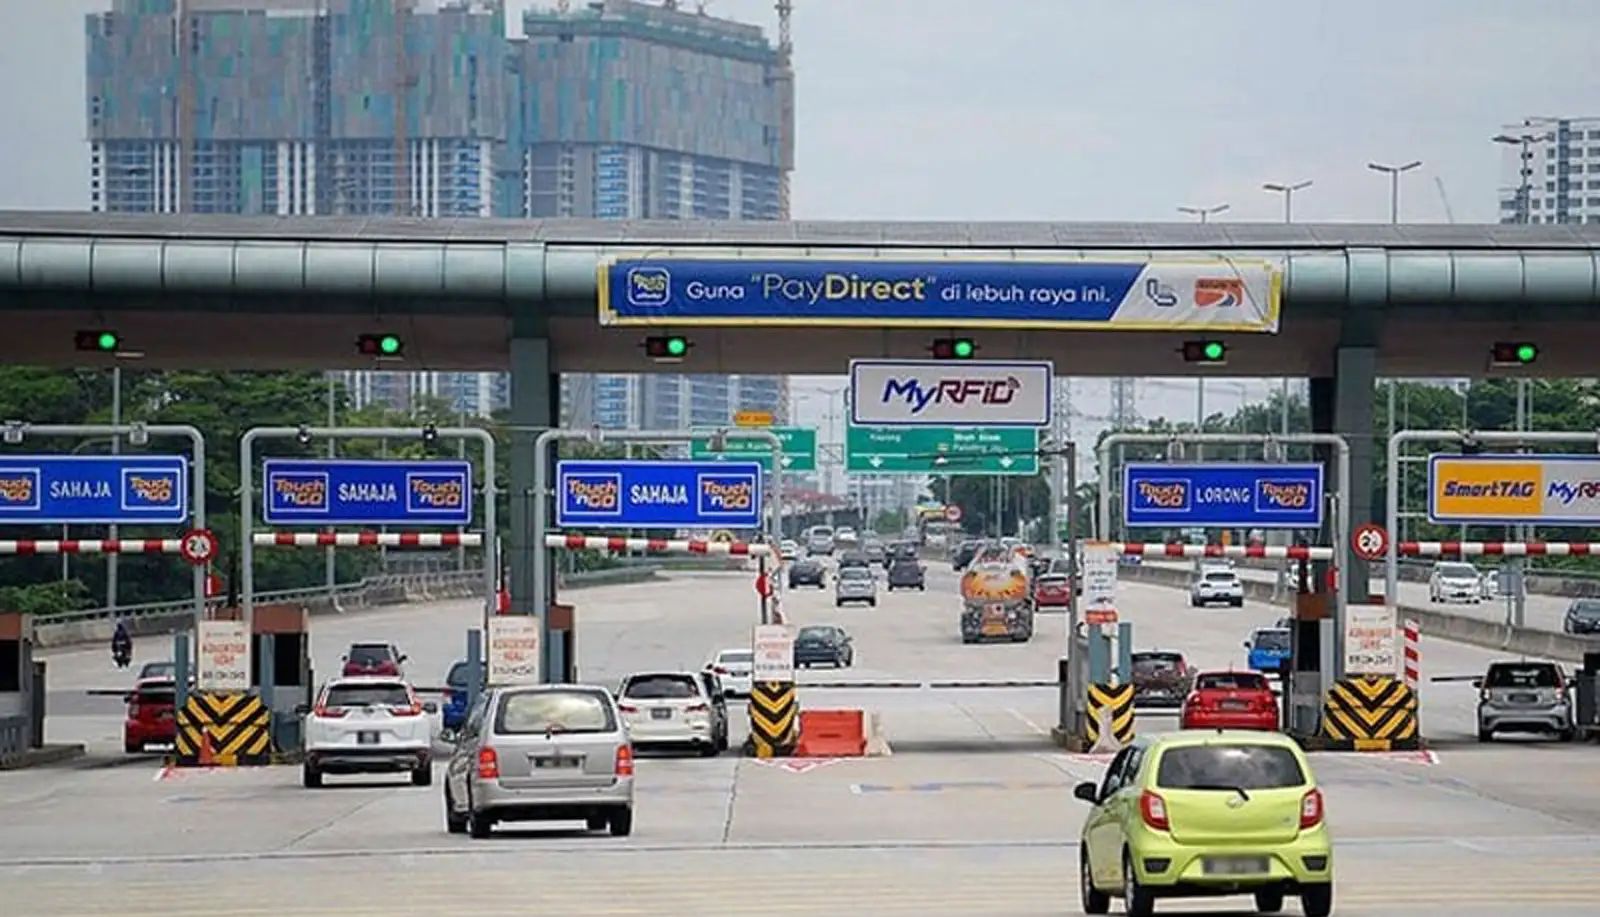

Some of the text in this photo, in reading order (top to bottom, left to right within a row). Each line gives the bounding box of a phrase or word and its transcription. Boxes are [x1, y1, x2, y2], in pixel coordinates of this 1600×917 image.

[687, 281, 744, 299] Guna
[941, 284, 960, 301] di
[966, 284, 1024, 302] lebuh
[1029, 288, 1077, 305] raya
[1082, 286, 1111, 303] ini.
[50, 480, 112, 498] SAHAJA
[275, 479, 324, 493] Touch
[338, 483, 397, 502] SAHAJA
[412, 479, 461, 493] Touch
[569, 480, 616, 495] Touch
[630, 484, 688, 504] SAHAJA
[703, 480, 751, 496] Touch
[1443, 481, 1535, 497] SmartTAG
[1196, 488, 1250, 503] LORONG
